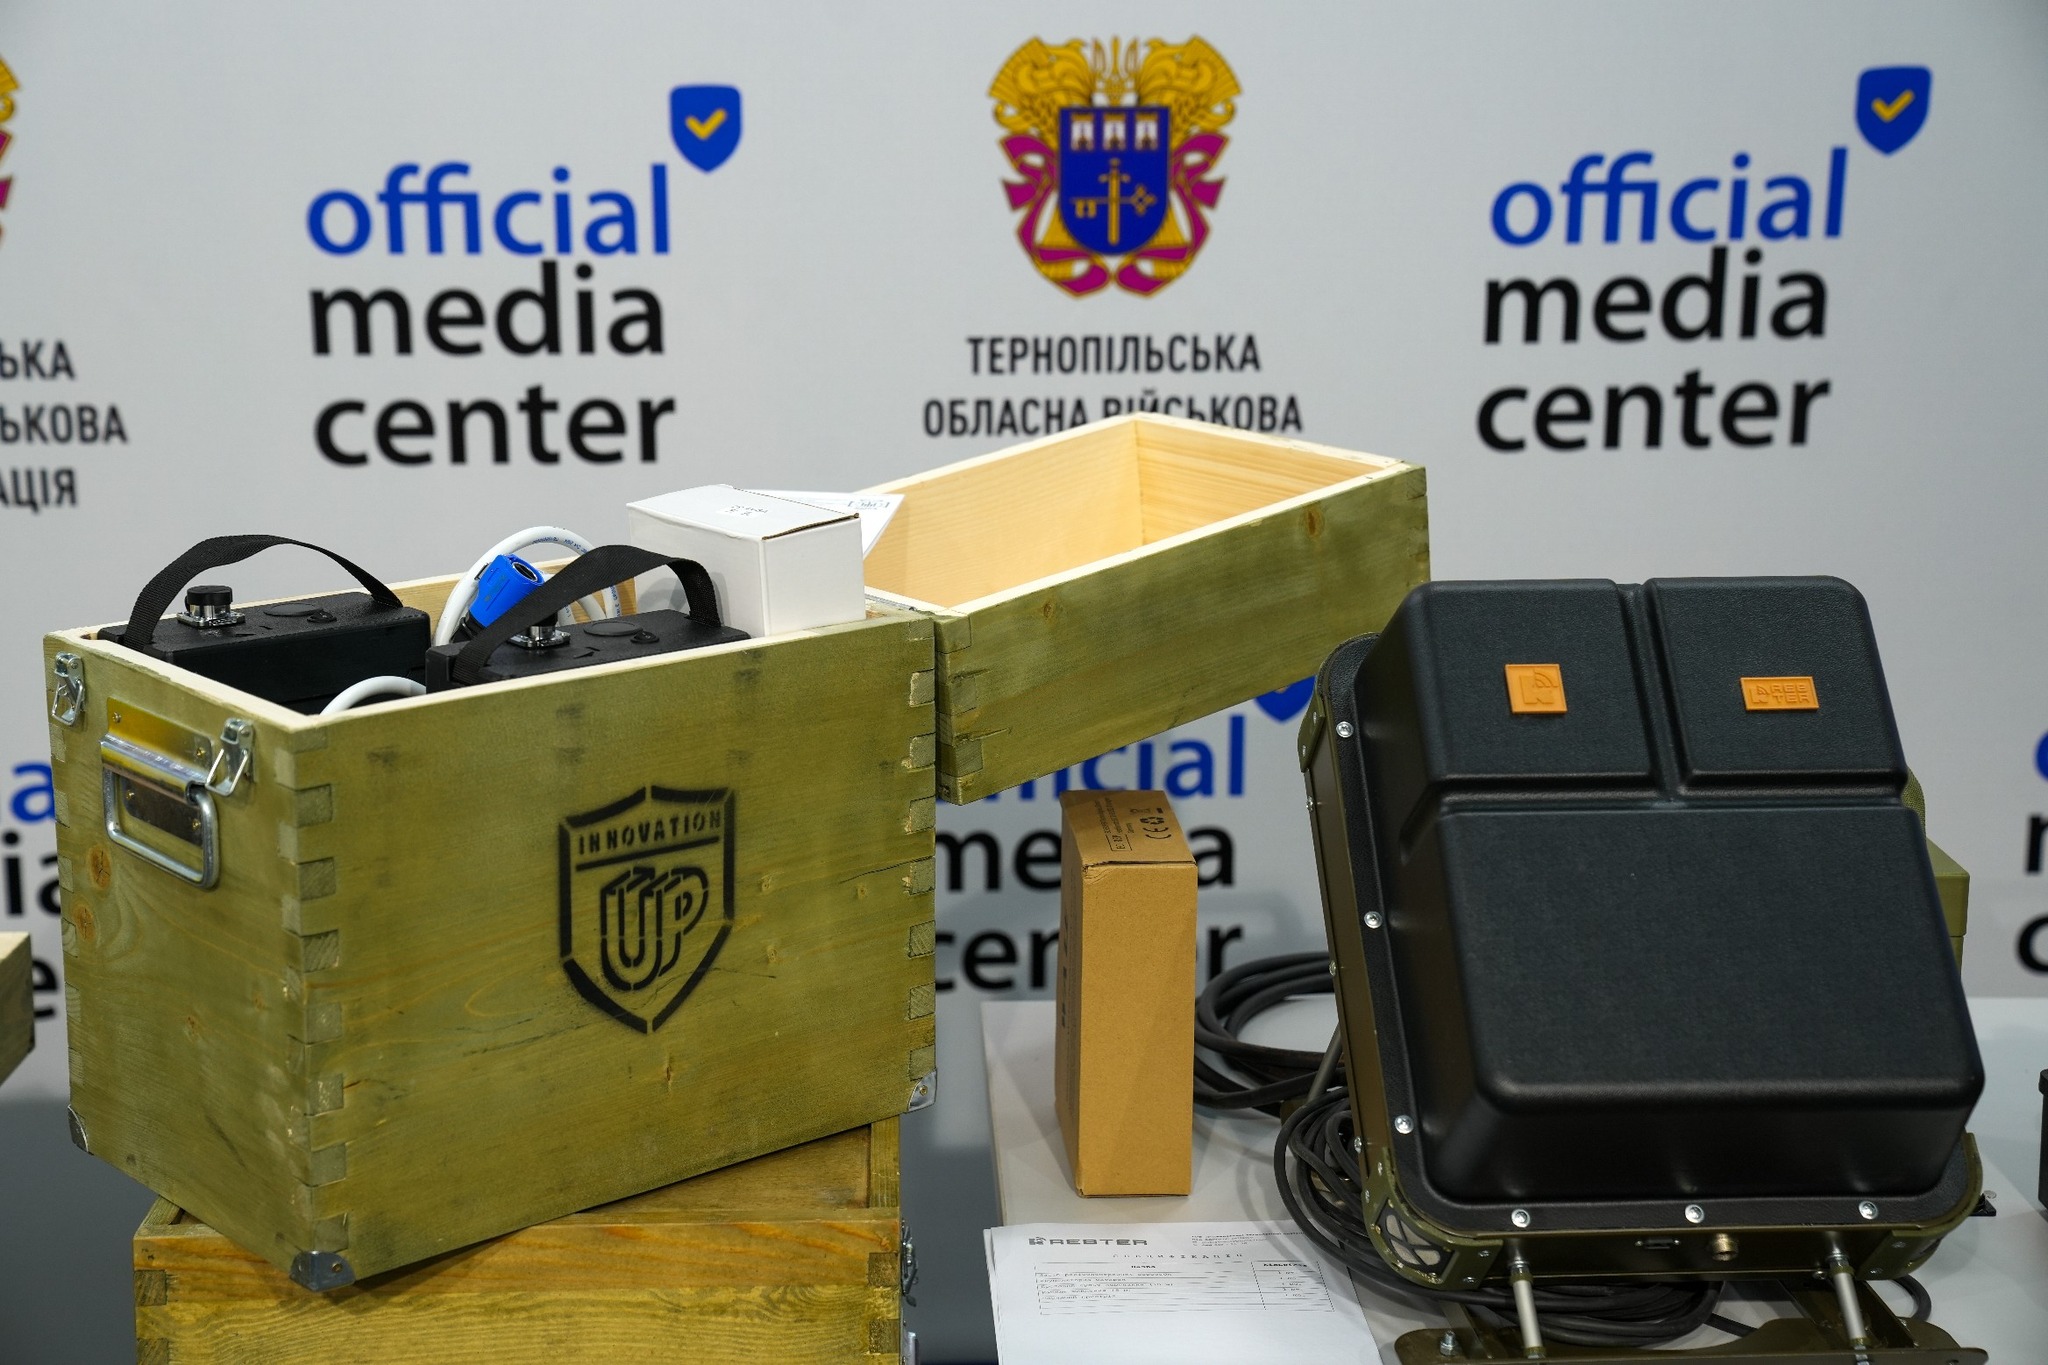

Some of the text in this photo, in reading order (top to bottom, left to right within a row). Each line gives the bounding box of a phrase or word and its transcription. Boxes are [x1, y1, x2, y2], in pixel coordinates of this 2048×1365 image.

[306, 162, 670, 257] official
[1489, 146, 1850, 248] official
[309, 260, 665, 356] media
[1482, 245, 1829, 345] media
[967, 334, 1262, 374] ТЕРНОПІЛЬСЬКА
[314, 384, 676, 468] center
[923, 397, 1089, 437] ОБЛАСНА
[1475, 368, 1832, 453] center
[579, 808, 721, 856] INNOVATION
[935, 825, 1236, 892] mea
[600, 866, 710, 991] UP
